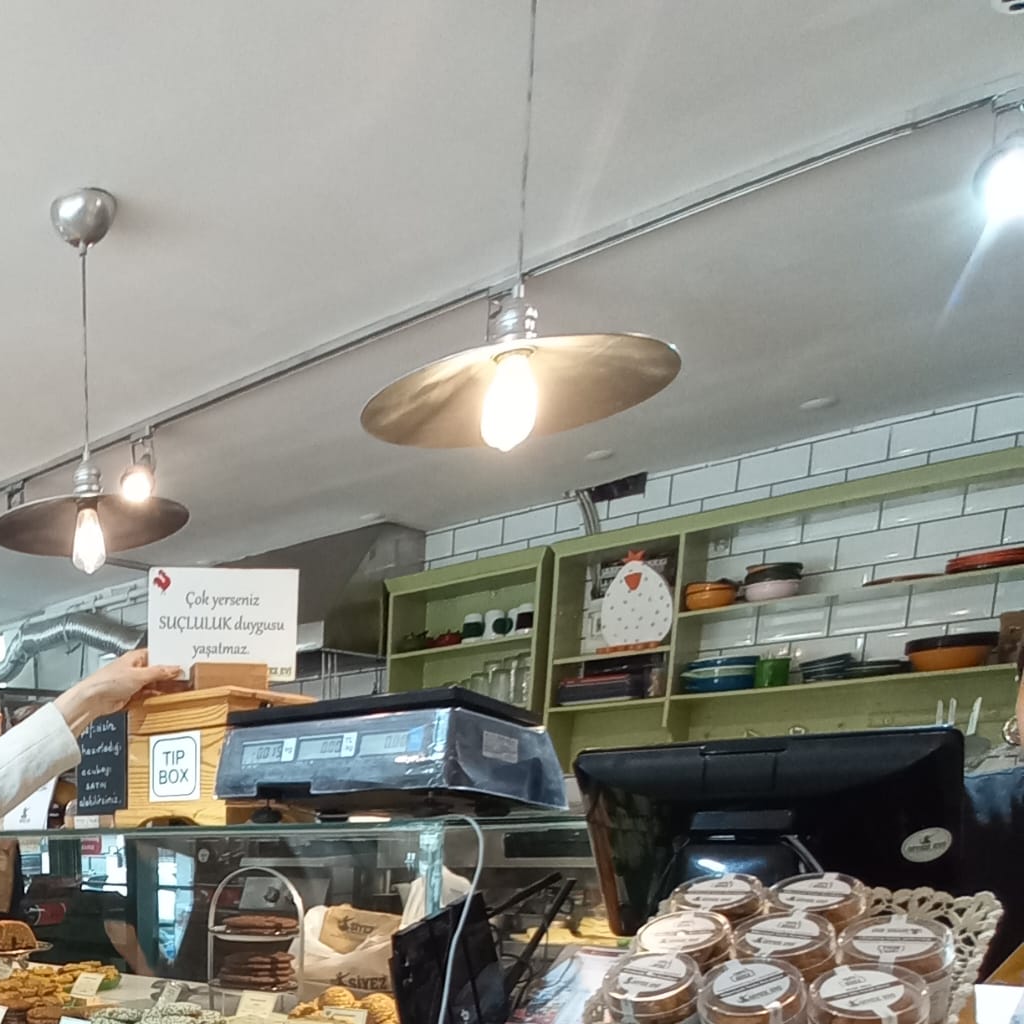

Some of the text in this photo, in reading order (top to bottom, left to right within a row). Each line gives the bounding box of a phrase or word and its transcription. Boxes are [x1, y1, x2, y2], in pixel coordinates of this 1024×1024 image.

[185, 590, 260, 610] Çok yerseniz
[158, 615, 285, 635] SUÇLULUK duygusu
[162, 750, 185, 766] TIP
[159, 768, 189, 785] BOX
